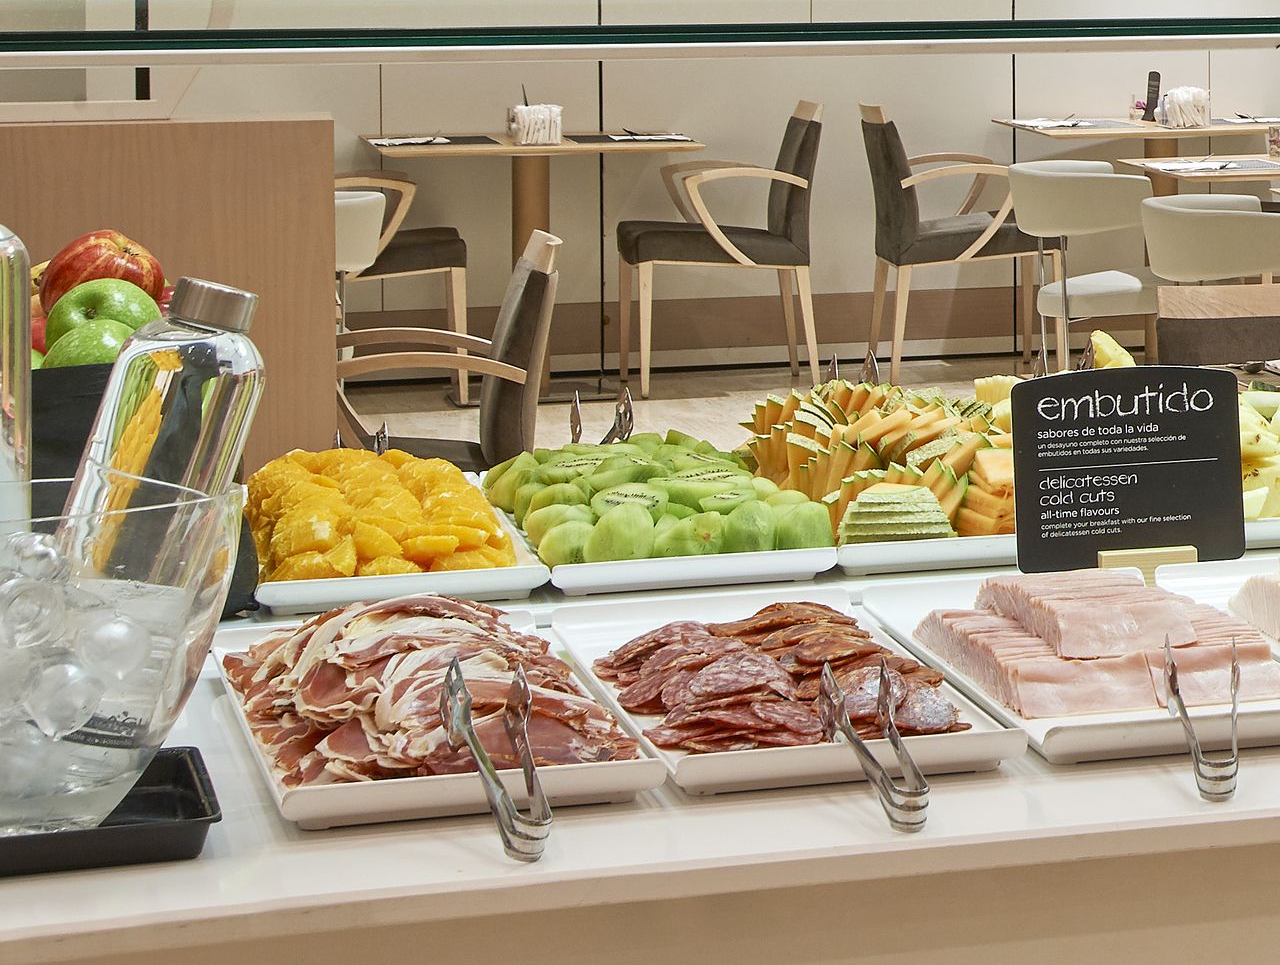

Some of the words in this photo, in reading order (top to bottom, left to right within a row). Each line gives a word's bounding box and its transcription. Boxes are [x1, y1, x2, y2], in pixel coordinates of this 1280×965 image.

[1036, 383, 1214, 421] embutido
[1037, 429, 1079, 439] sabores
[1081, 427, 1095, 436] de
[1098, 425, 1122, 435] toda
[1125, 424, 1134, 433] la
[1136, 422, 1159, 432] vida
[1047, 441, 1078, 449] desayuno
[1148, 435, 1177, 443] selección
[1113, 445, 1148, 453] variedades.
[1039, 472, 1137, 491] delicatessen
[1039, 491, 1074, 506] cold
[1079, 489, 1115, 503] cuts
[1040, 509, 1078, 519] all-time
[1080, 507, 1120, 517] flavours
[1040, 522, 1072, 530] complete
[1073, 521, 1088, 529] your
[1089, 519, 1120, 527] breakfast
[1050, 529, 1090, 537] delicatessen
